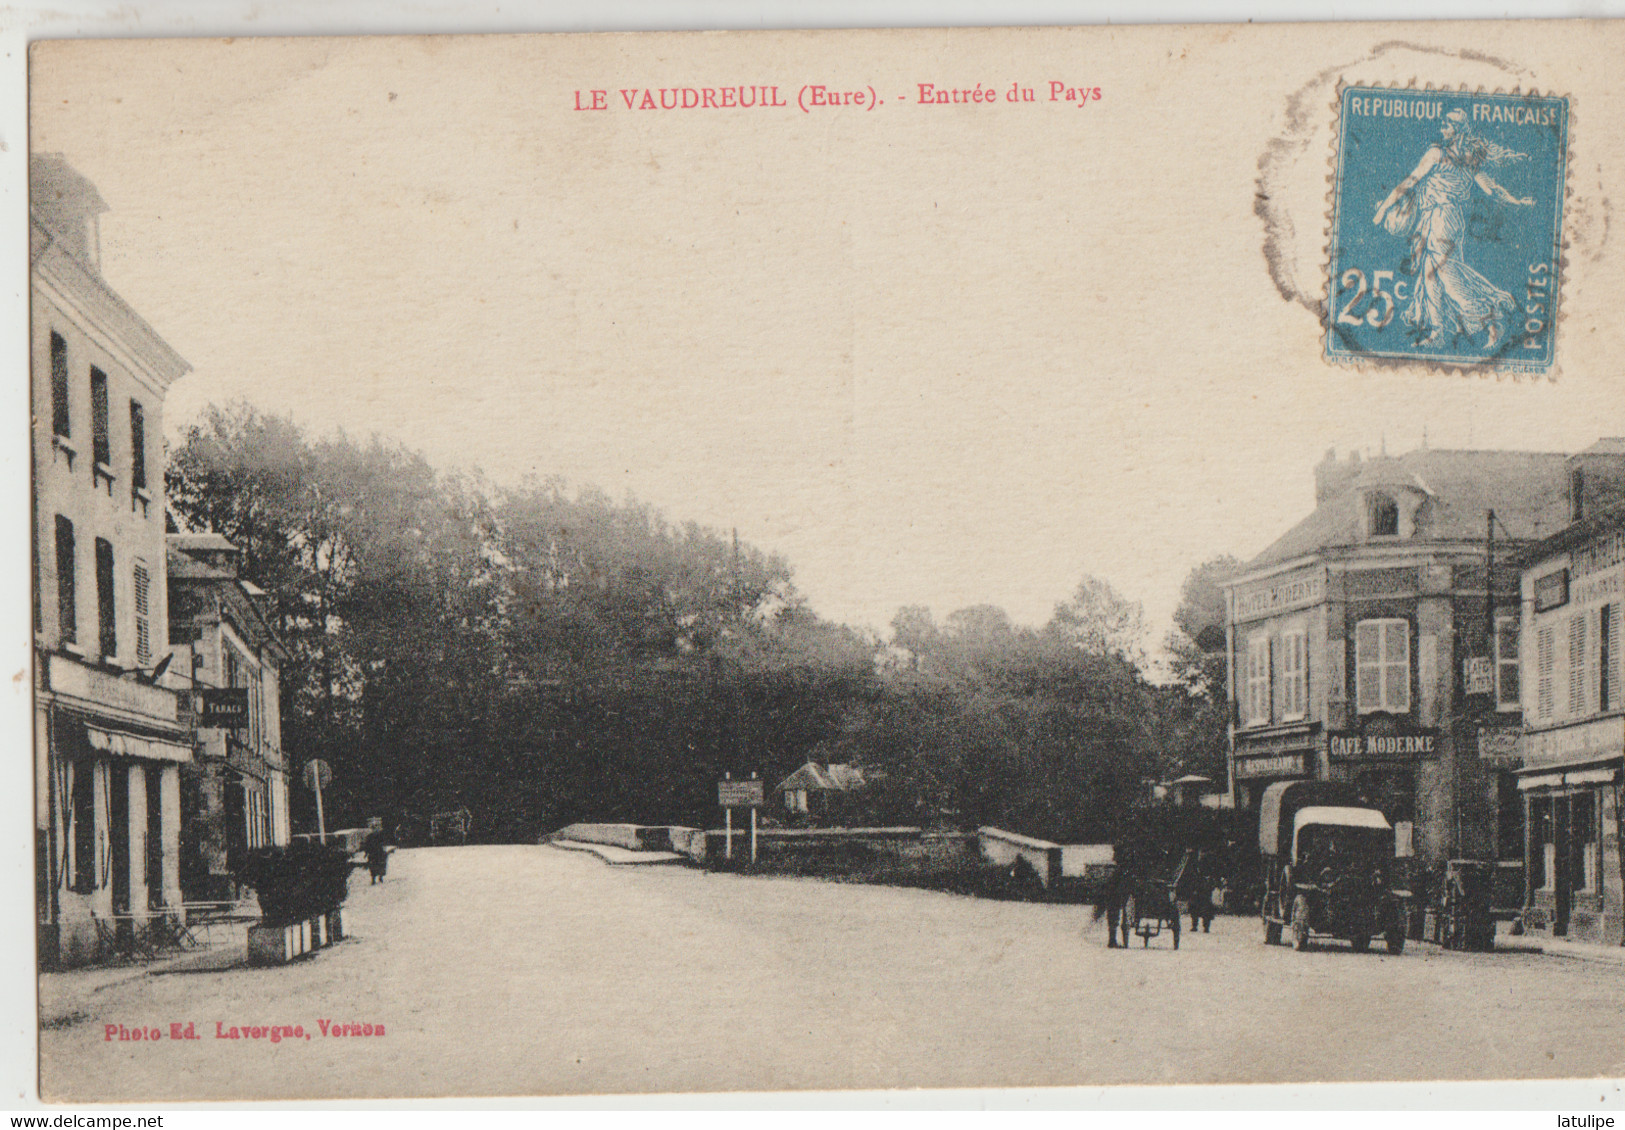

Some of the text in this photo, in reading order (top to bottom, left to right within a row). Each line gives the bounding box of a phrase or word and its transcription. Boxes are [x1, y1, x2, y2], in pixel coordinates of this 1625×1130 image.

[1472, 103, 1558, 126] FRANÇAISE
[1523, 262, 1549, 349] POSTES
[1366, 735, 1434, 754] MODERNE
